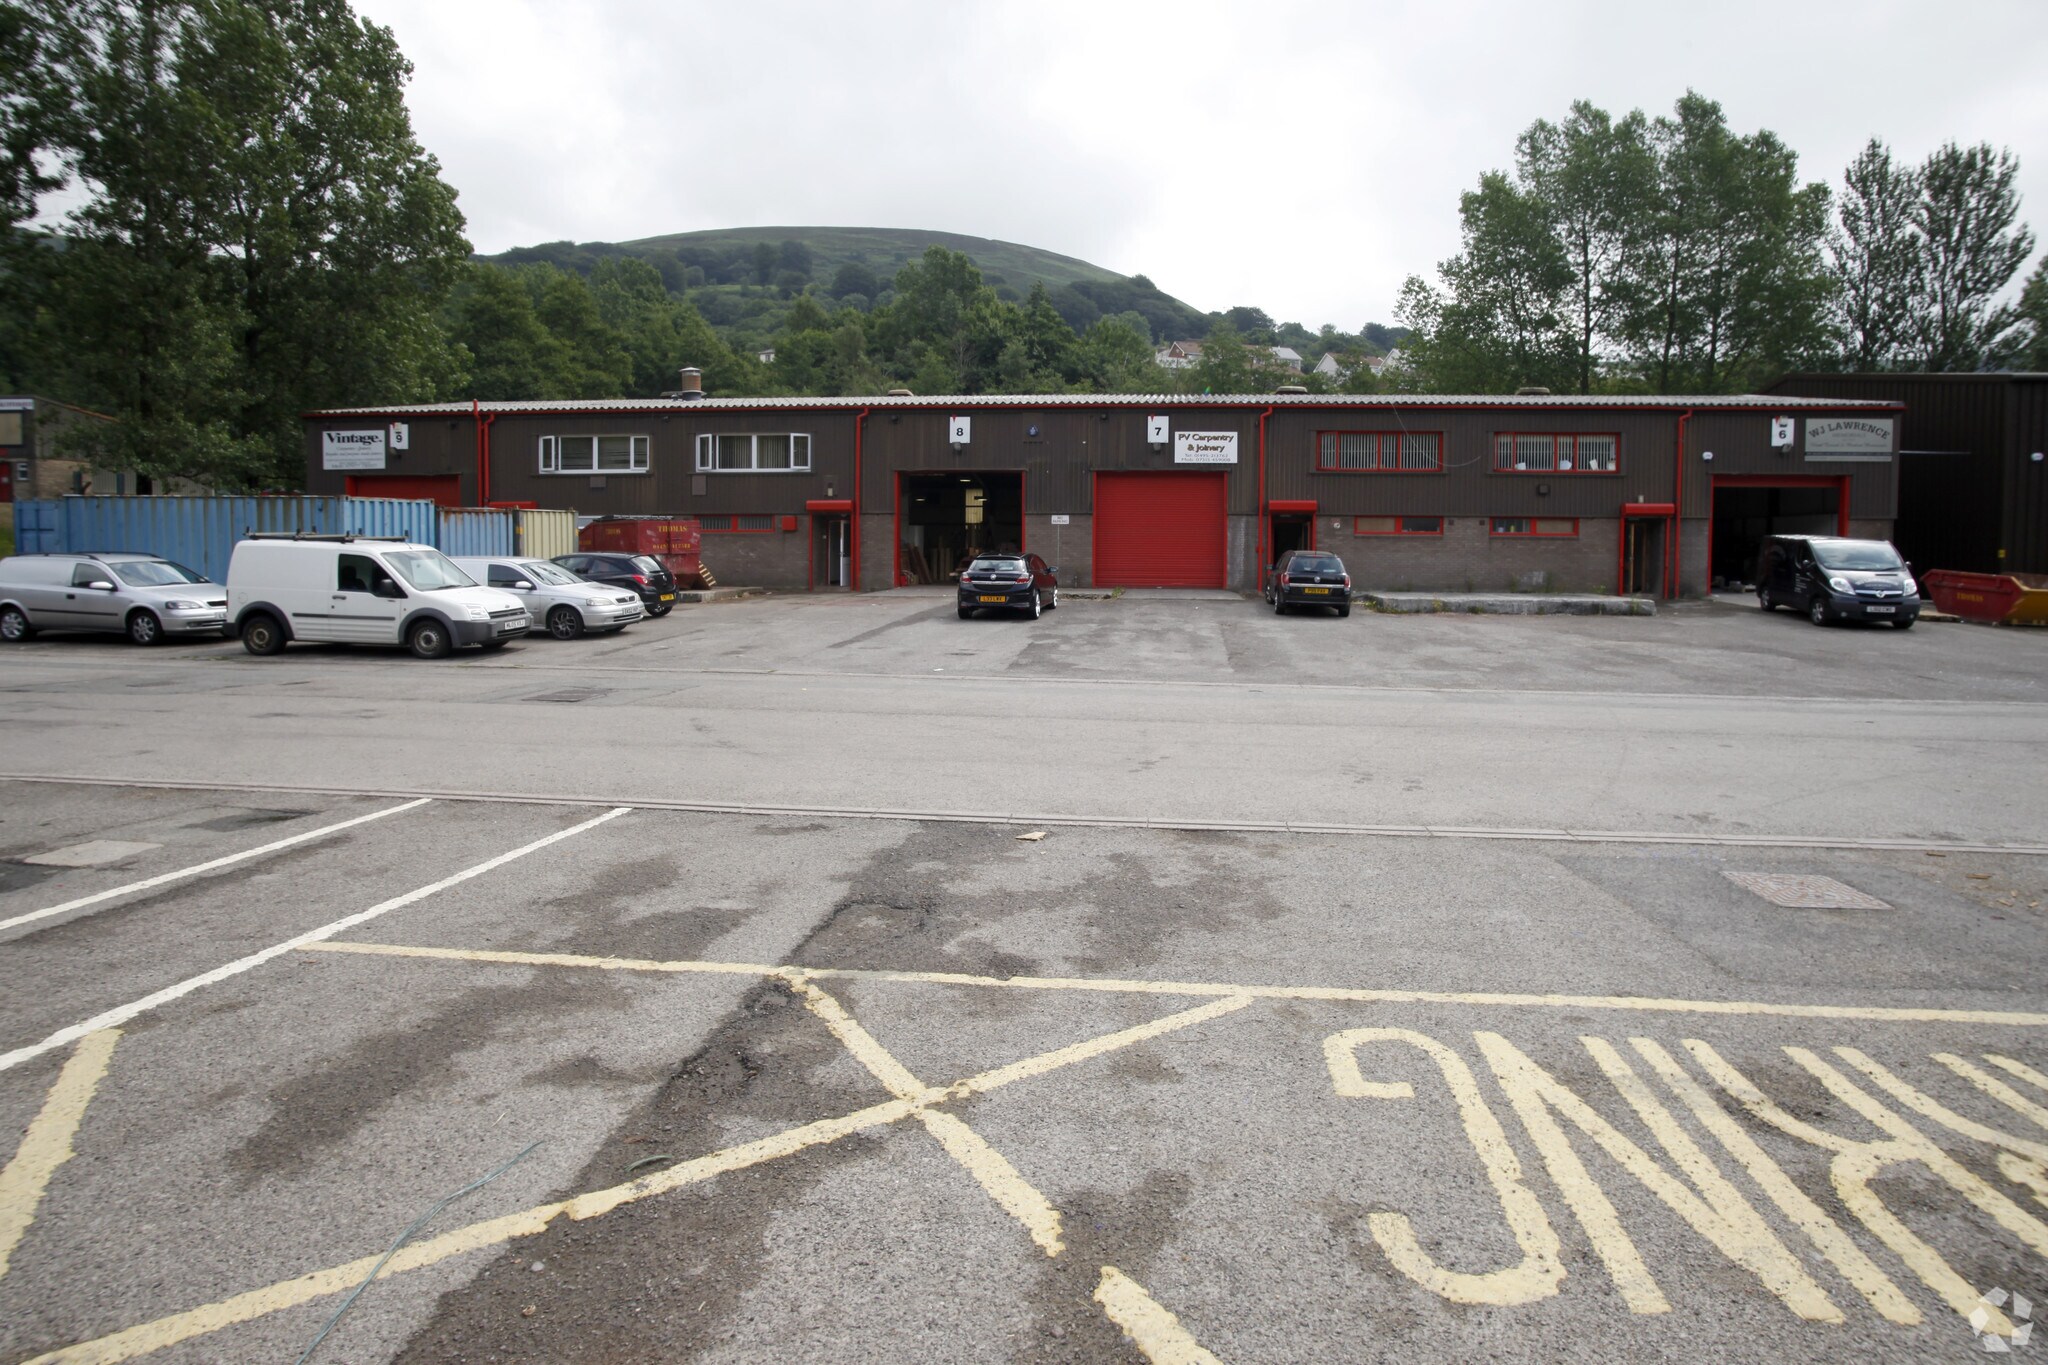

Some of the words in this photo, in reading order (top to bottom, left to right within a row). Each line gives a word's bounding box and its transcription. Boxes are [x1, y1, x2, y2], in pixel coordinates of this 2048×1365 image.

[956, 427, 964, 436] 8
[1154, 427, 1162, 436] 7
[1778, 430, 1787, 439] 6
[1808, 426, 1826, 438] WJ
[1828, 421, 1890, 439] LAWRENCE
[395, 434, 403, 443] 9
[1178, 433, 1191, 441] PV
[1192, 433, 1234, 442] Carpentry
[1187, 444, 1195, 452] &
[1195, 444, 1226, 453] Joinery
